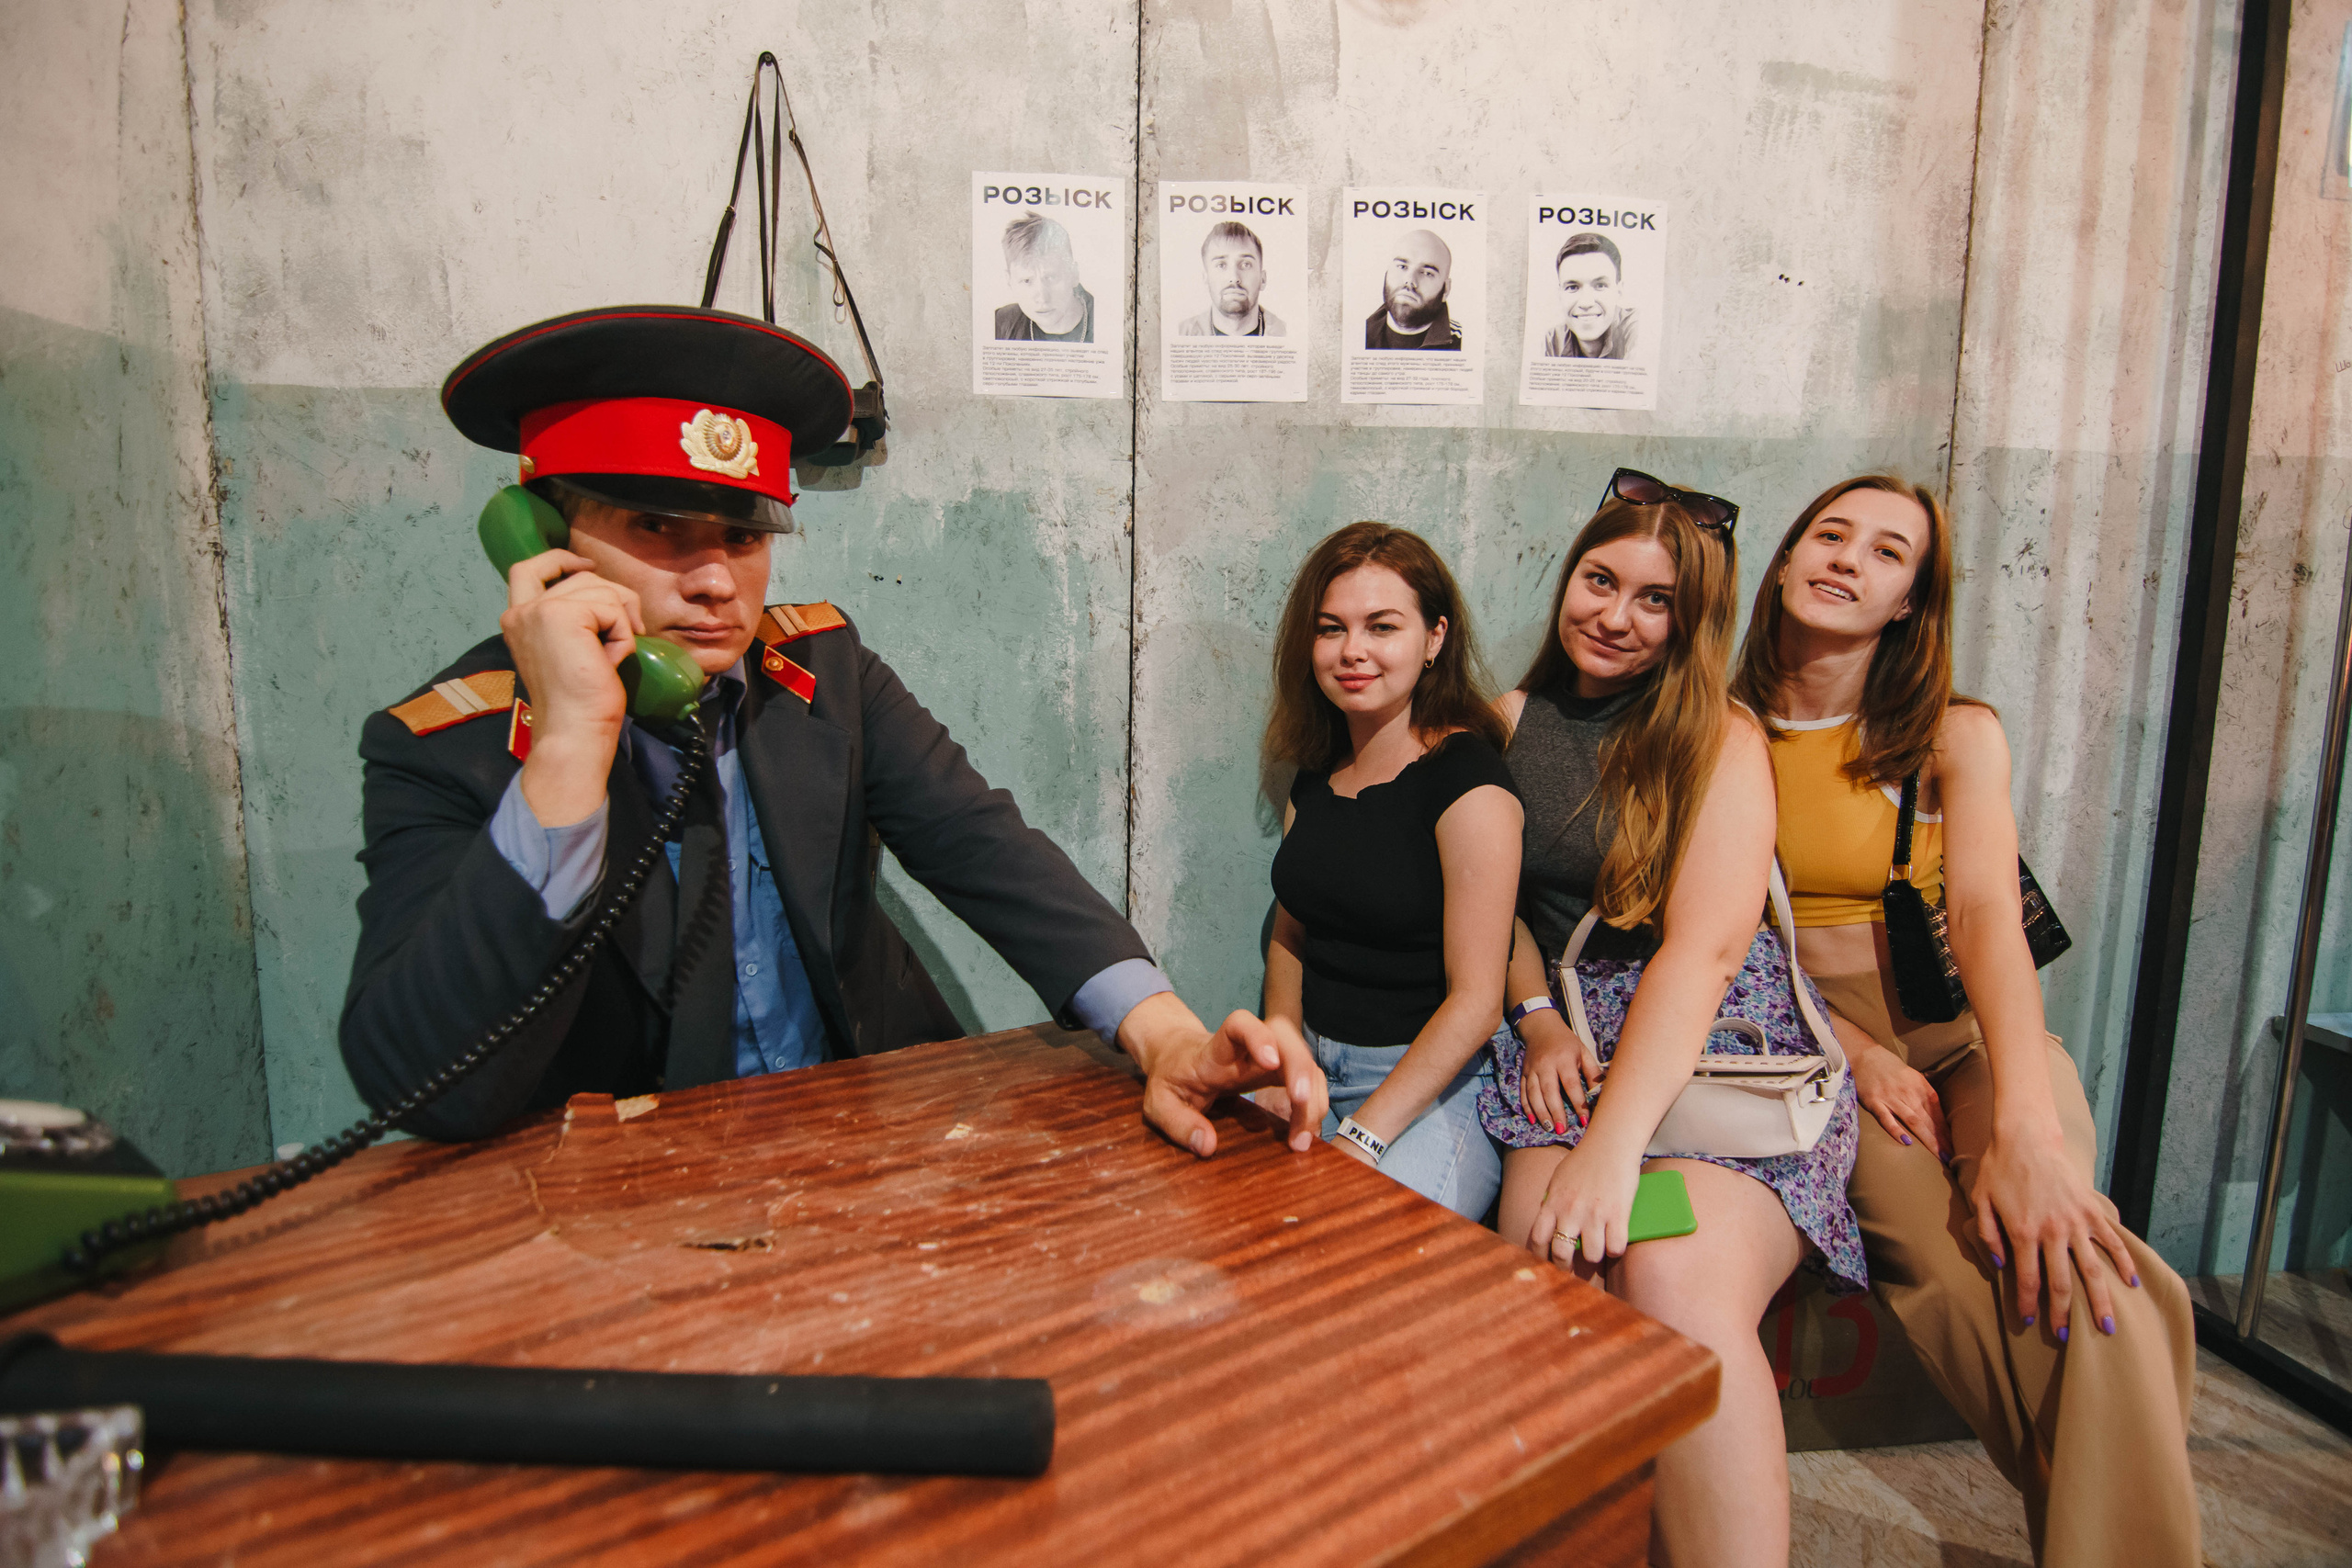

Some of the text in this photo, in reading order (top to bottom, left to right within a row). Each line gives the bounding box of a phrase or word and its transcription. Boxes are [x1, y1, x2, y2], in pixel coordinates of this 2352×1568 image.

[982, 185, 1114, 210] РОЗЫСК
[1170, 194, 1295, 216] РОЗЫСК
[1352, 199, 1476, 221] РОЗЫСК
[1538, 206, 1656, 231] РОЗЫСК
[1349, 1126, 1385, 1156] PKLNE
